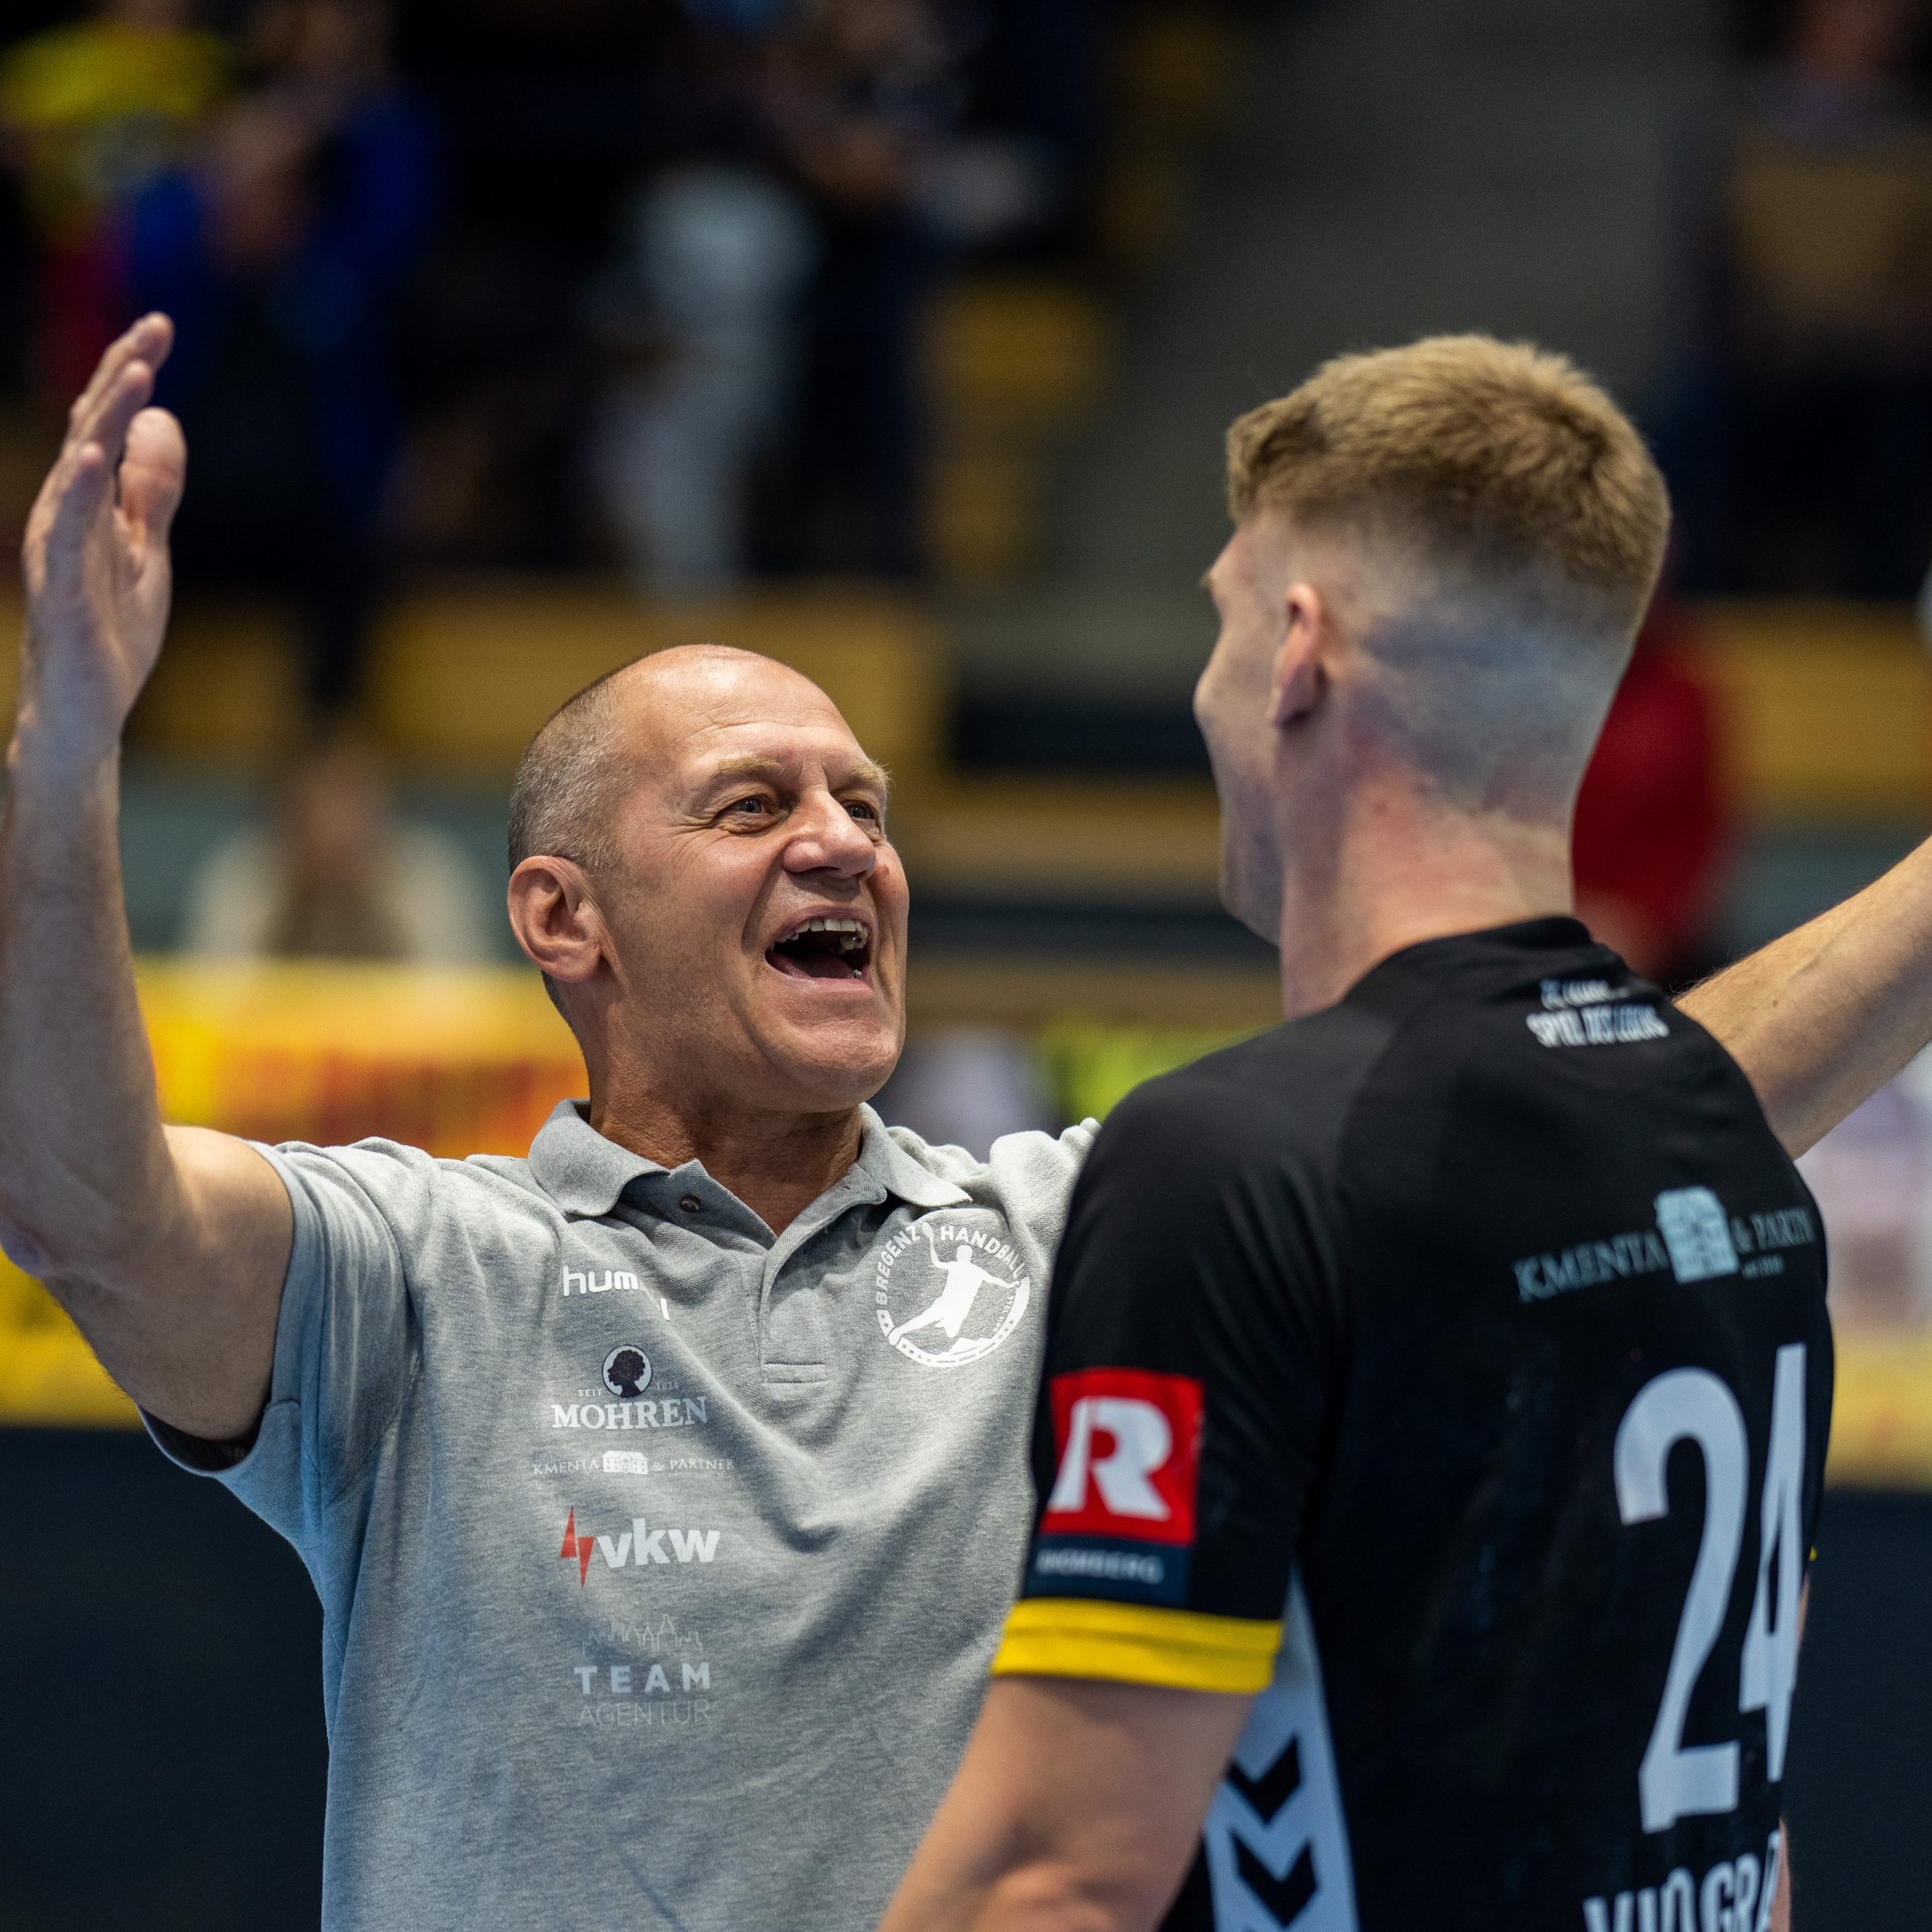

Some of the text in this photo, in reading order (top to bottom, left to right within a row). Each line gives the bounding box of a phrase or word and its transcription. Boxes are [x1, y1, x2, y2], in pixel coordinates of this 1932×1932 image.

[875, 1225, 1025, 1306] BREGENZ HANDBALL
[1513, 1230, 1670, 1304] KMENTA
[563, 1266, 670, 1321] huml
[551, 1395, 708, 1430] MOHREN
[578, 1388, 604, 1398] SEIT
[533, 1457, 735, 1476] KMENTA & PARTNER
[1046, 1395, 1174, 1522] R
[596, 1518, 720, 1569] vkw
[1613, 1342, 1807, 1835] 24
[573, 1662, 711, 1695] TEAM
[577, 1699, 711, 1727] AGENTUR
